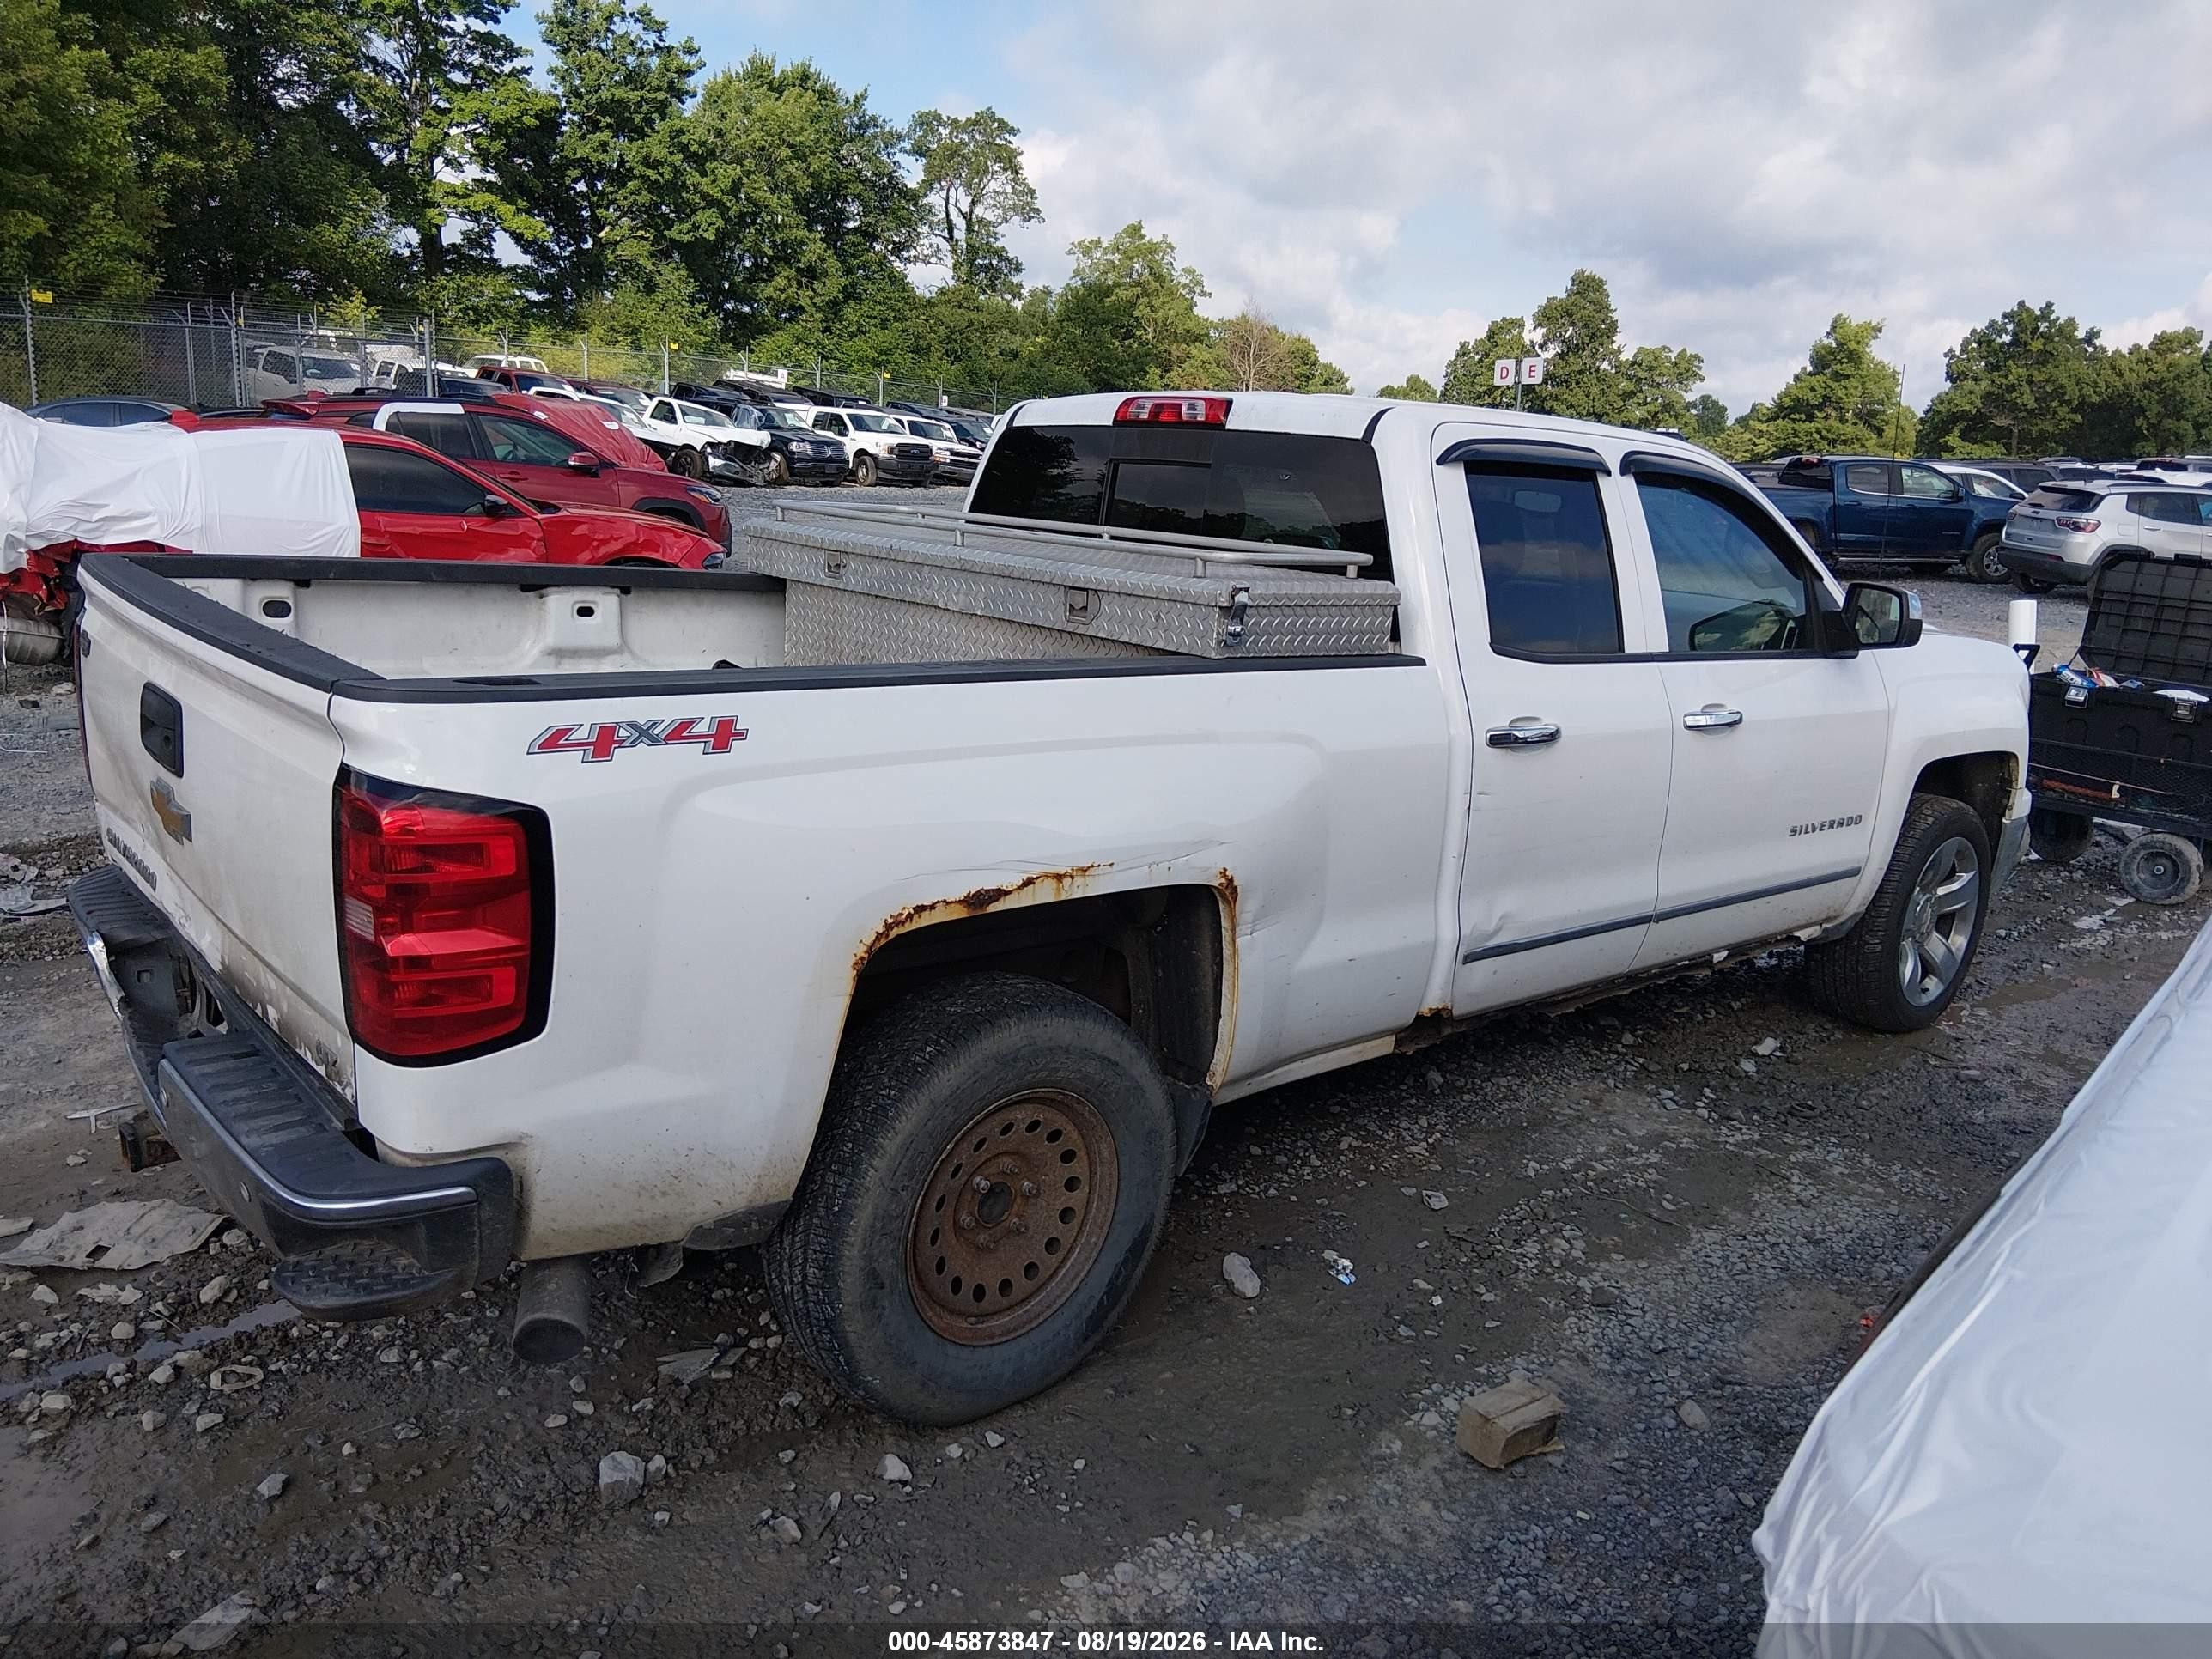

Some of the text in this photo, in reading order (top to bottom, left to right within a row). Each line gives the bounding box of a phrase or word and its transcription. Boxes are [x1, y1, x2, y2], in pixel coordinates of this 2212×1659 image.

[1499, 366, 1510, 380] D
[1528, 364, 1537, 378] E
[1789, 815, 1863, 836] SILVERADO
